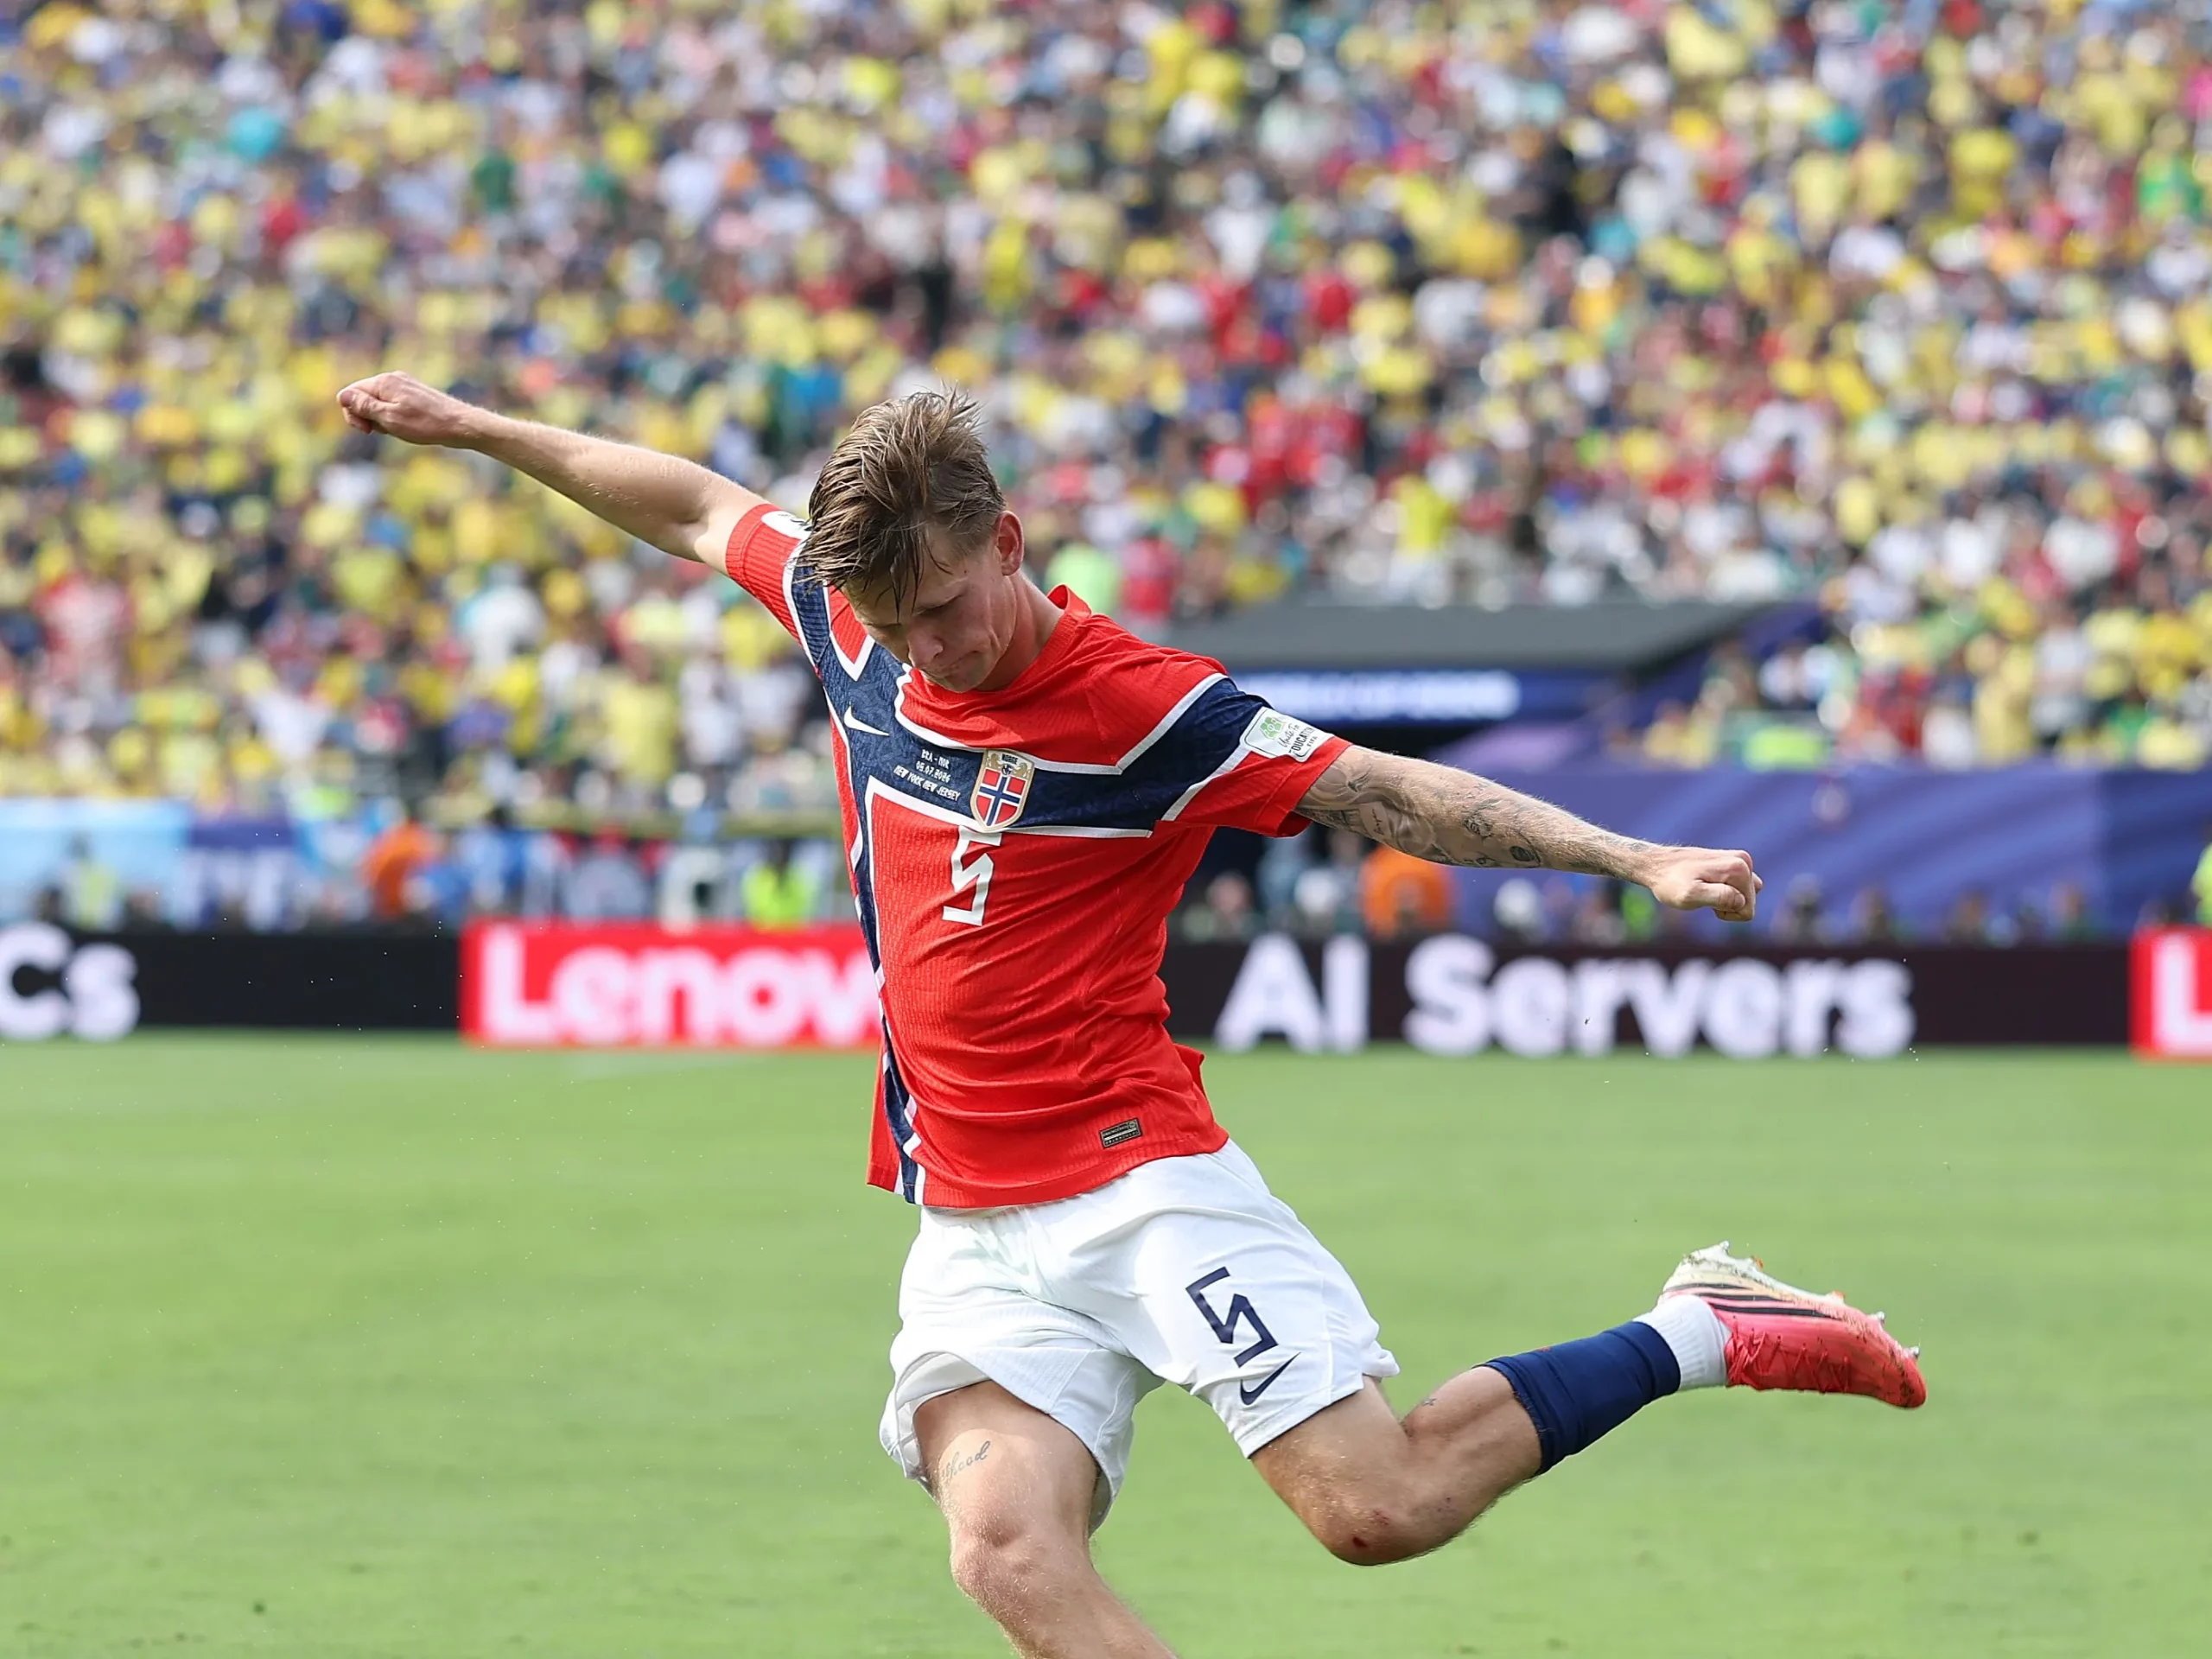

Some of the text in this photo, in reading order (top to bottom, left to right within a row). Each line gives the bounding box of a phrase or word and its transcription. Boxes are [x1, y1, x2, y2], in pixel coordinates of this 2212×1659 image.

[916, 760, 951, 783] 05.07.2026
[921, 749, 933, 762] BRA
[1306, 736, 1319, 747] FIFA
[893, 765, 961, 801] NEW YORK NEW JERSEY
[942, 825, 1002, 927] 5
[484, 925, 881, 1046] Lenov
[1213, 933, 1916, 1058] AI Servers
[1185, 1266, 1279, 1369] 5
